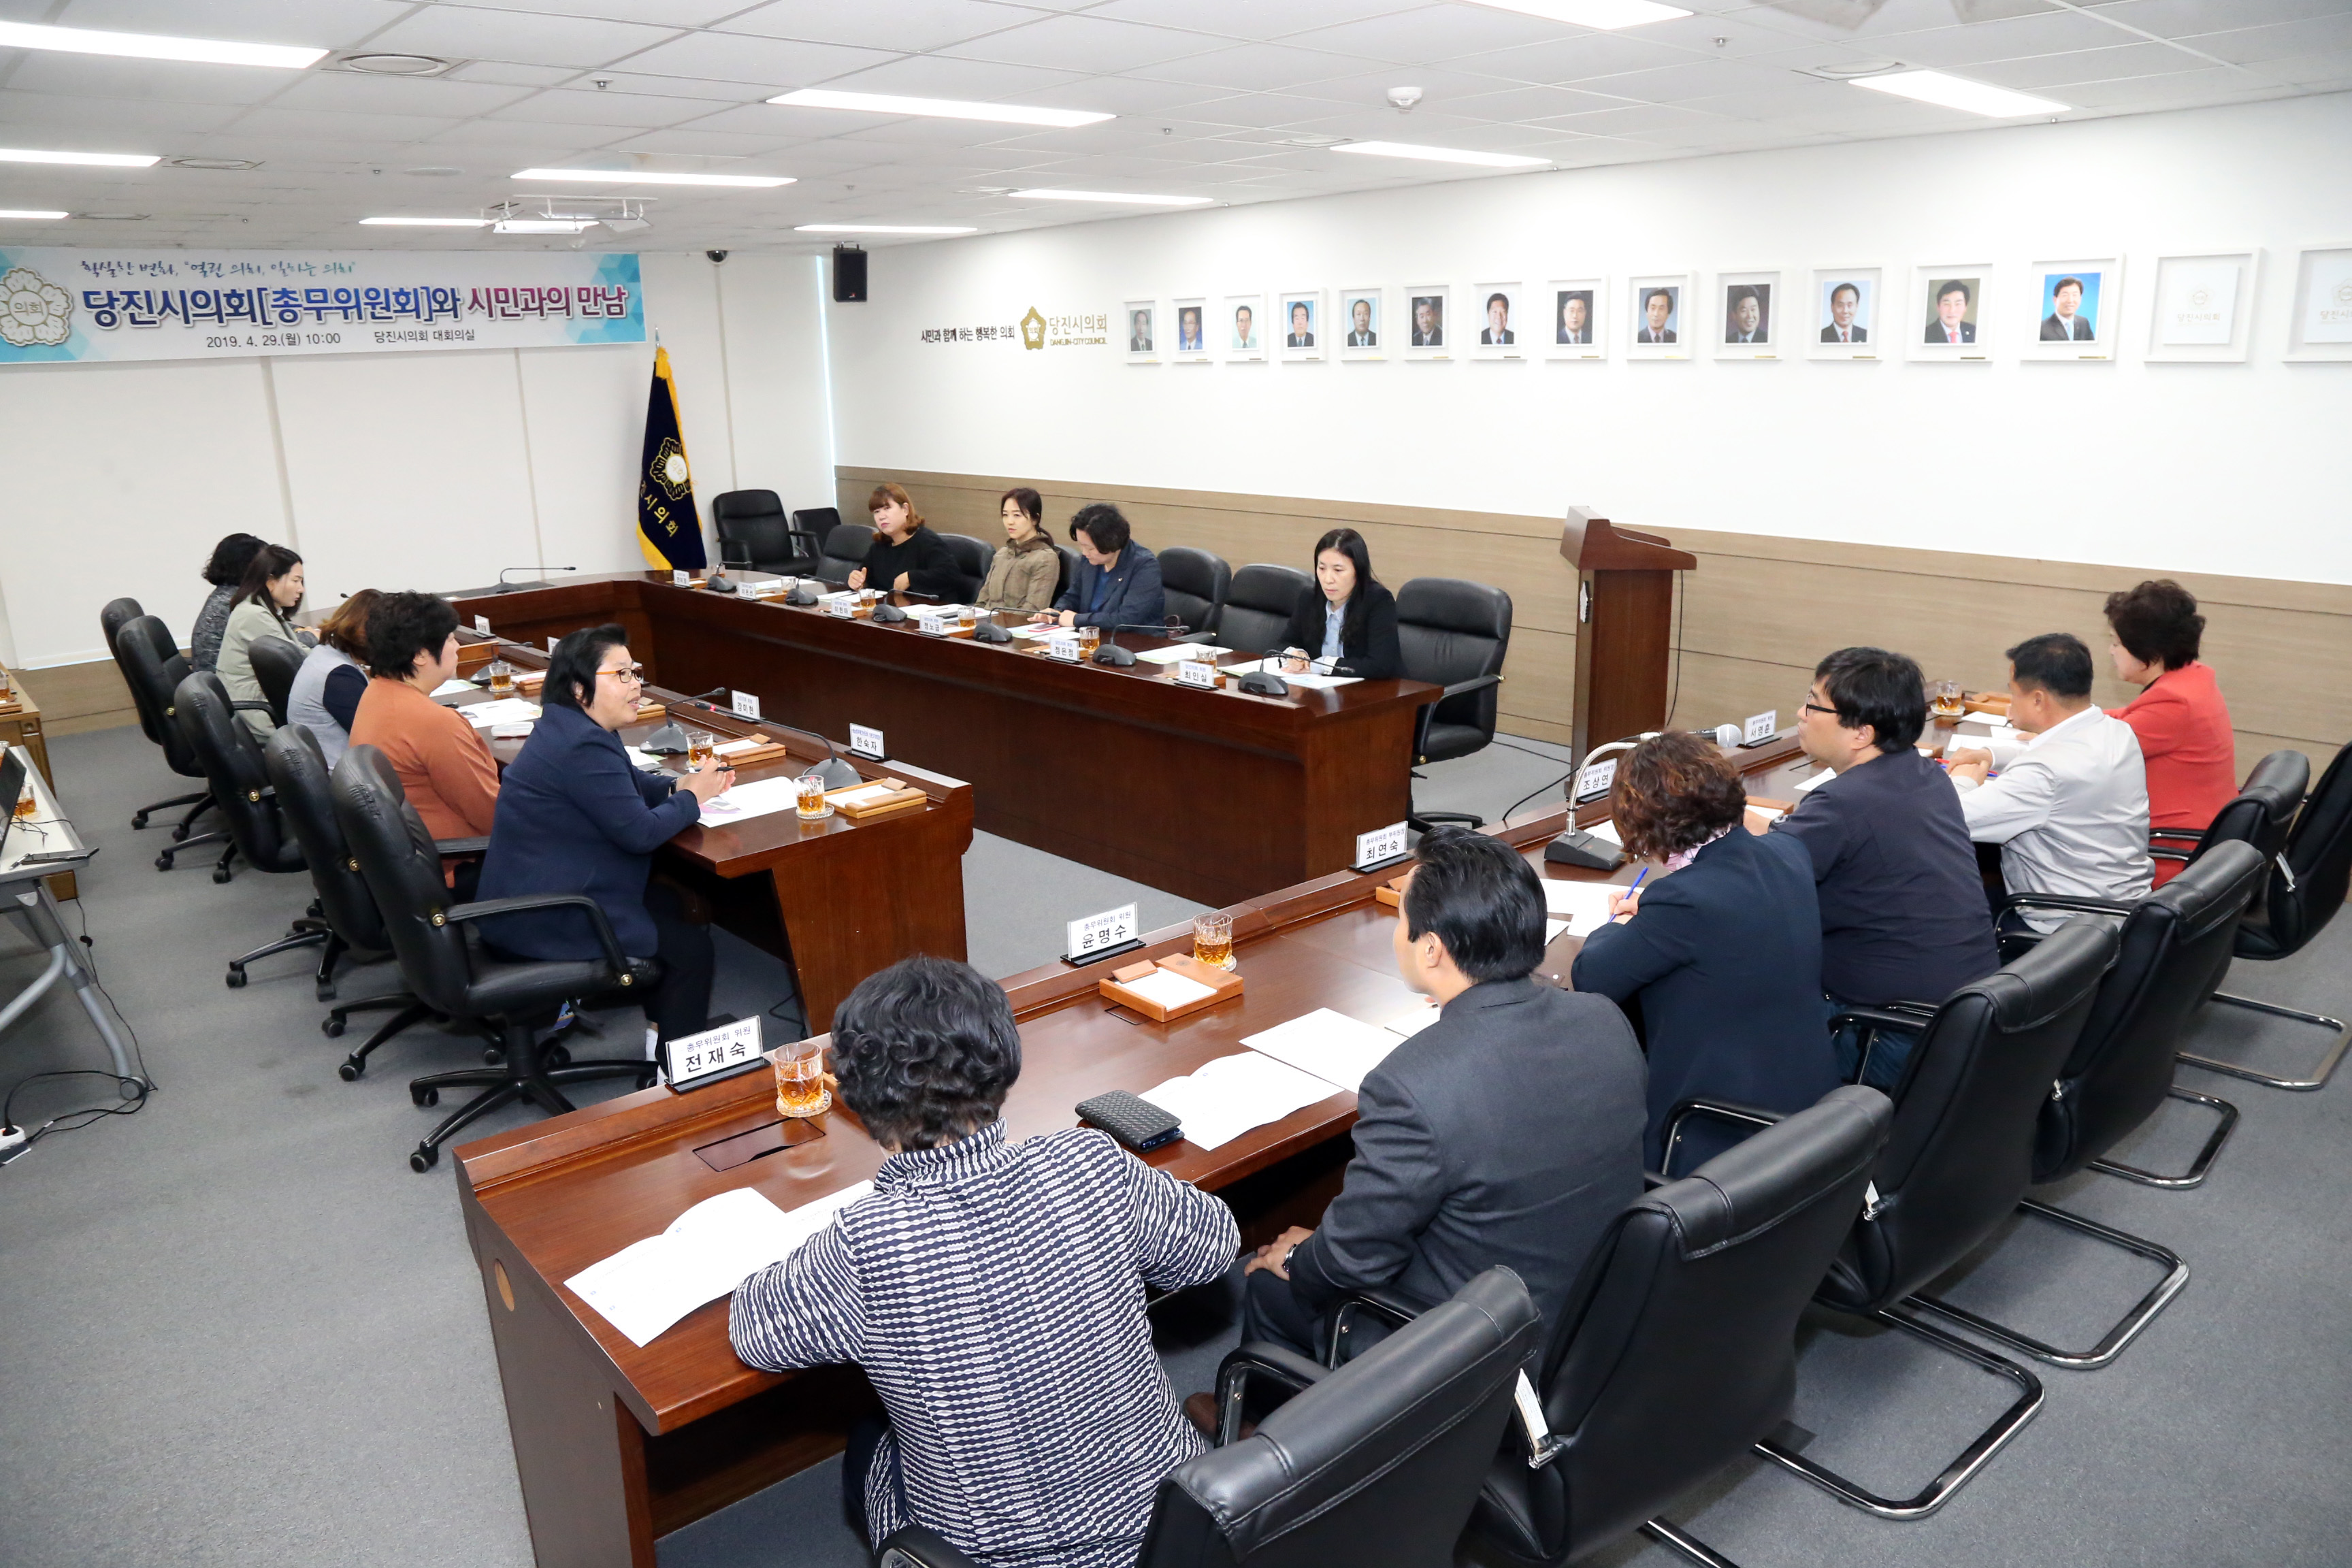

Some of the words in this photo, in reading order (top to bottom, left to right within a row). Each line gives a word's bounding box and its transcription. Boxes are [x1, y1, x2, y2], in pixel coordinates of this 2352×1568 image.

[14, 301, 44, 316] 의회
[467, 286, 571, 319] 시민과의
[577, 284, 627, 316] 만남
[2320, 310, 2352, 320] 당진시
[921, 328, 941, 343] 시민과
[959, 327, 973, 342] 하는
[975, 326, 998, 341] 행복한
[1000, 325, 1015, 340] 의회
[1049, 314, 1107, 336] 당진시의회
[207, 336, 242, 348] 2019.
[246, 335, 258, 347] 4.
[306, 333, 340, 344] 10:00
[374, 330, 429, 342] 당진시의회
[433, 328, 475, 341] 대회의실
[856, 736, 877, 752] 한숙자
[1582, 773, 1609, 791] 조상연
[1367, 834, 1386, 845] 총무위원회
[1389, 828, 1405, 837] 부위원장
[1367, 840, 1398, 859] 최연숙
[1083, 915, 1115, 932] 총무위원회
[1119, 911, 1132, 920] 위원
[1081, 924, 1127, 949] 윤명수
[686, 1032, 730, 1052] 총무위원회
[734, 1026, 751, 1037] 위원
[685, 1042, 747, 1073] 전재숙
